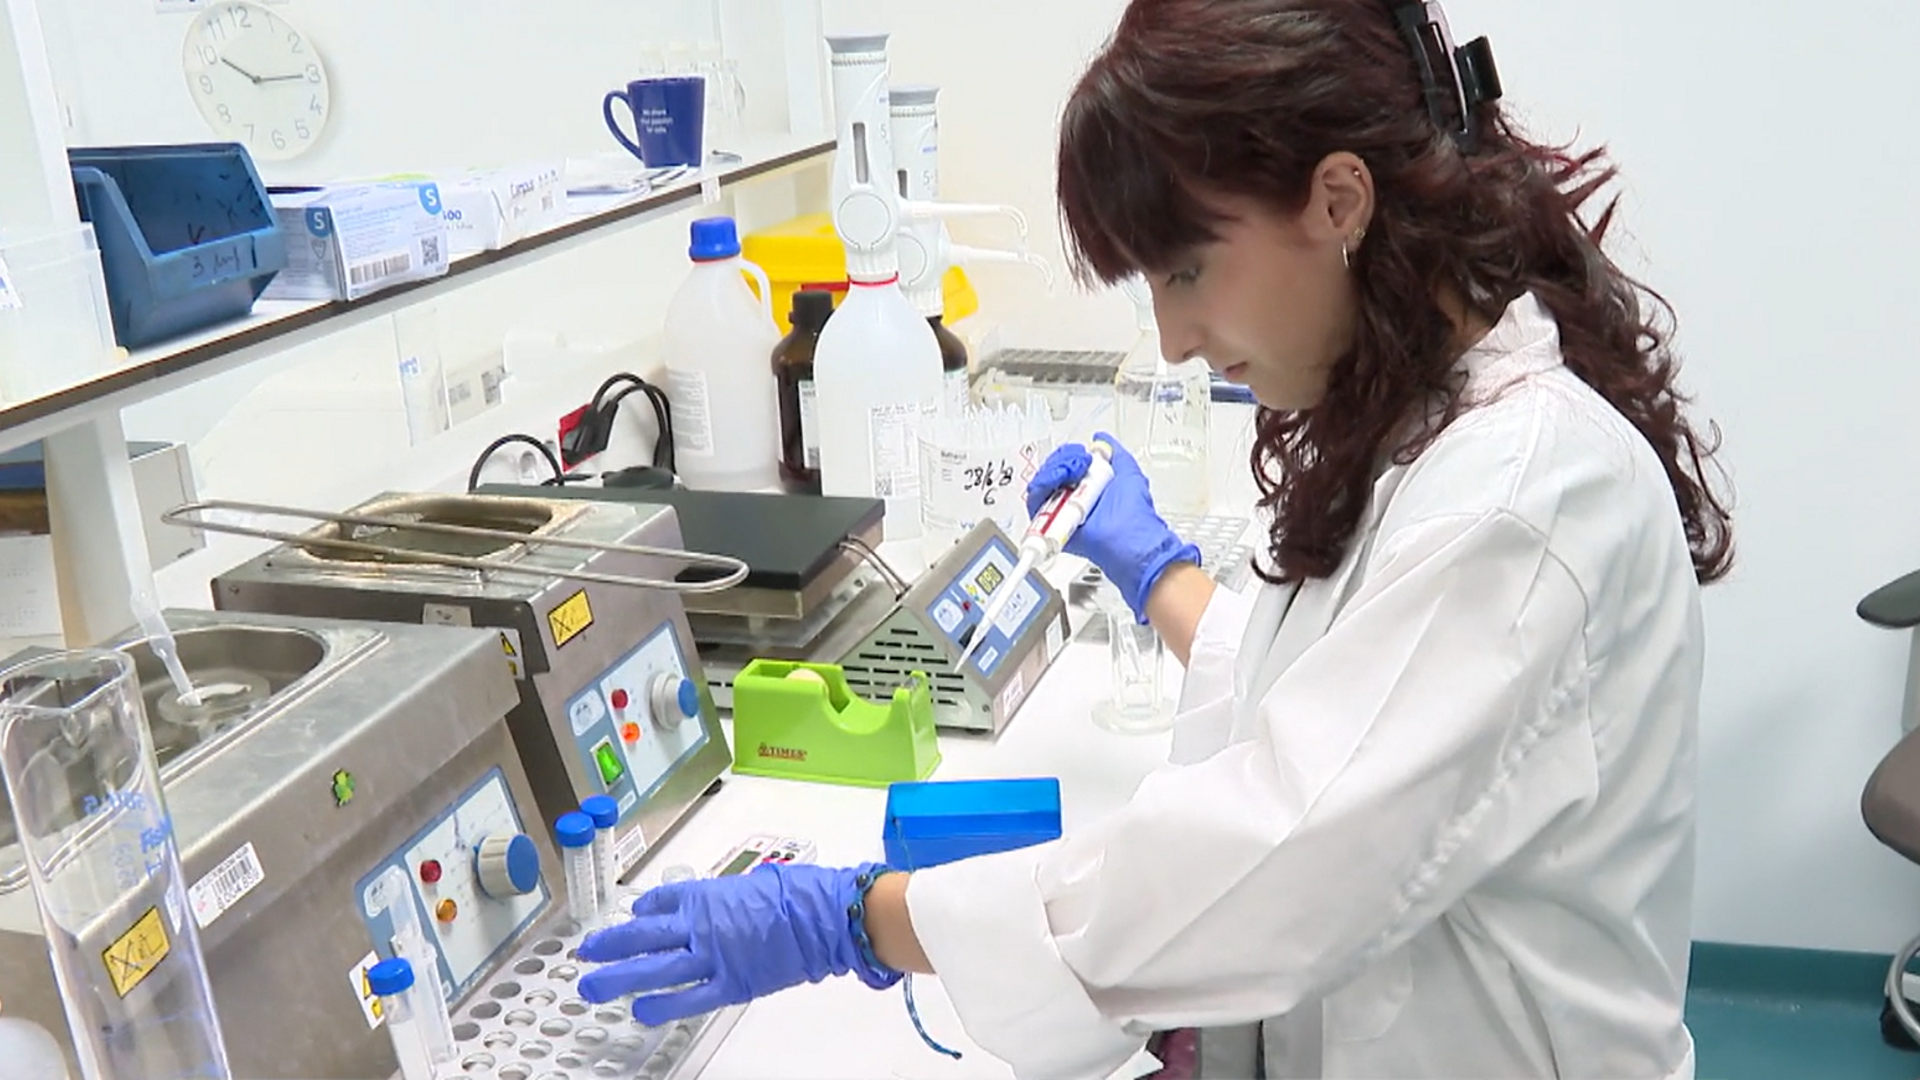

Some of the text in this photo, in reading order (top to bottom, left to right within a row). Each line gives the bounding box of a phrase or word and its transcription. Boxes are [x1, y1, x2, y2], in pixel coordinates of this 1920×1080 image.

[227, 5, 252, 28] 12
[265, 12, 275, 33] 1
[207, 18, 226, 41] 11
[287, 32, 304, 54] 2
[196, 45, 218, 66] 10
[306, 63, 322, 84] 3
[199, 75, 214, 95] 9
[216, 104, 232, 124] 8
[310, 94, 323, 116] 4
[242, 123, 256, 142] 7
[271, 130, 287, 150] 6
[294, 119, 311, 140] 5
[425, 189, 437, 208] S
[313, 212, 325, 231] S
[192, 256, 206, 279] 3
